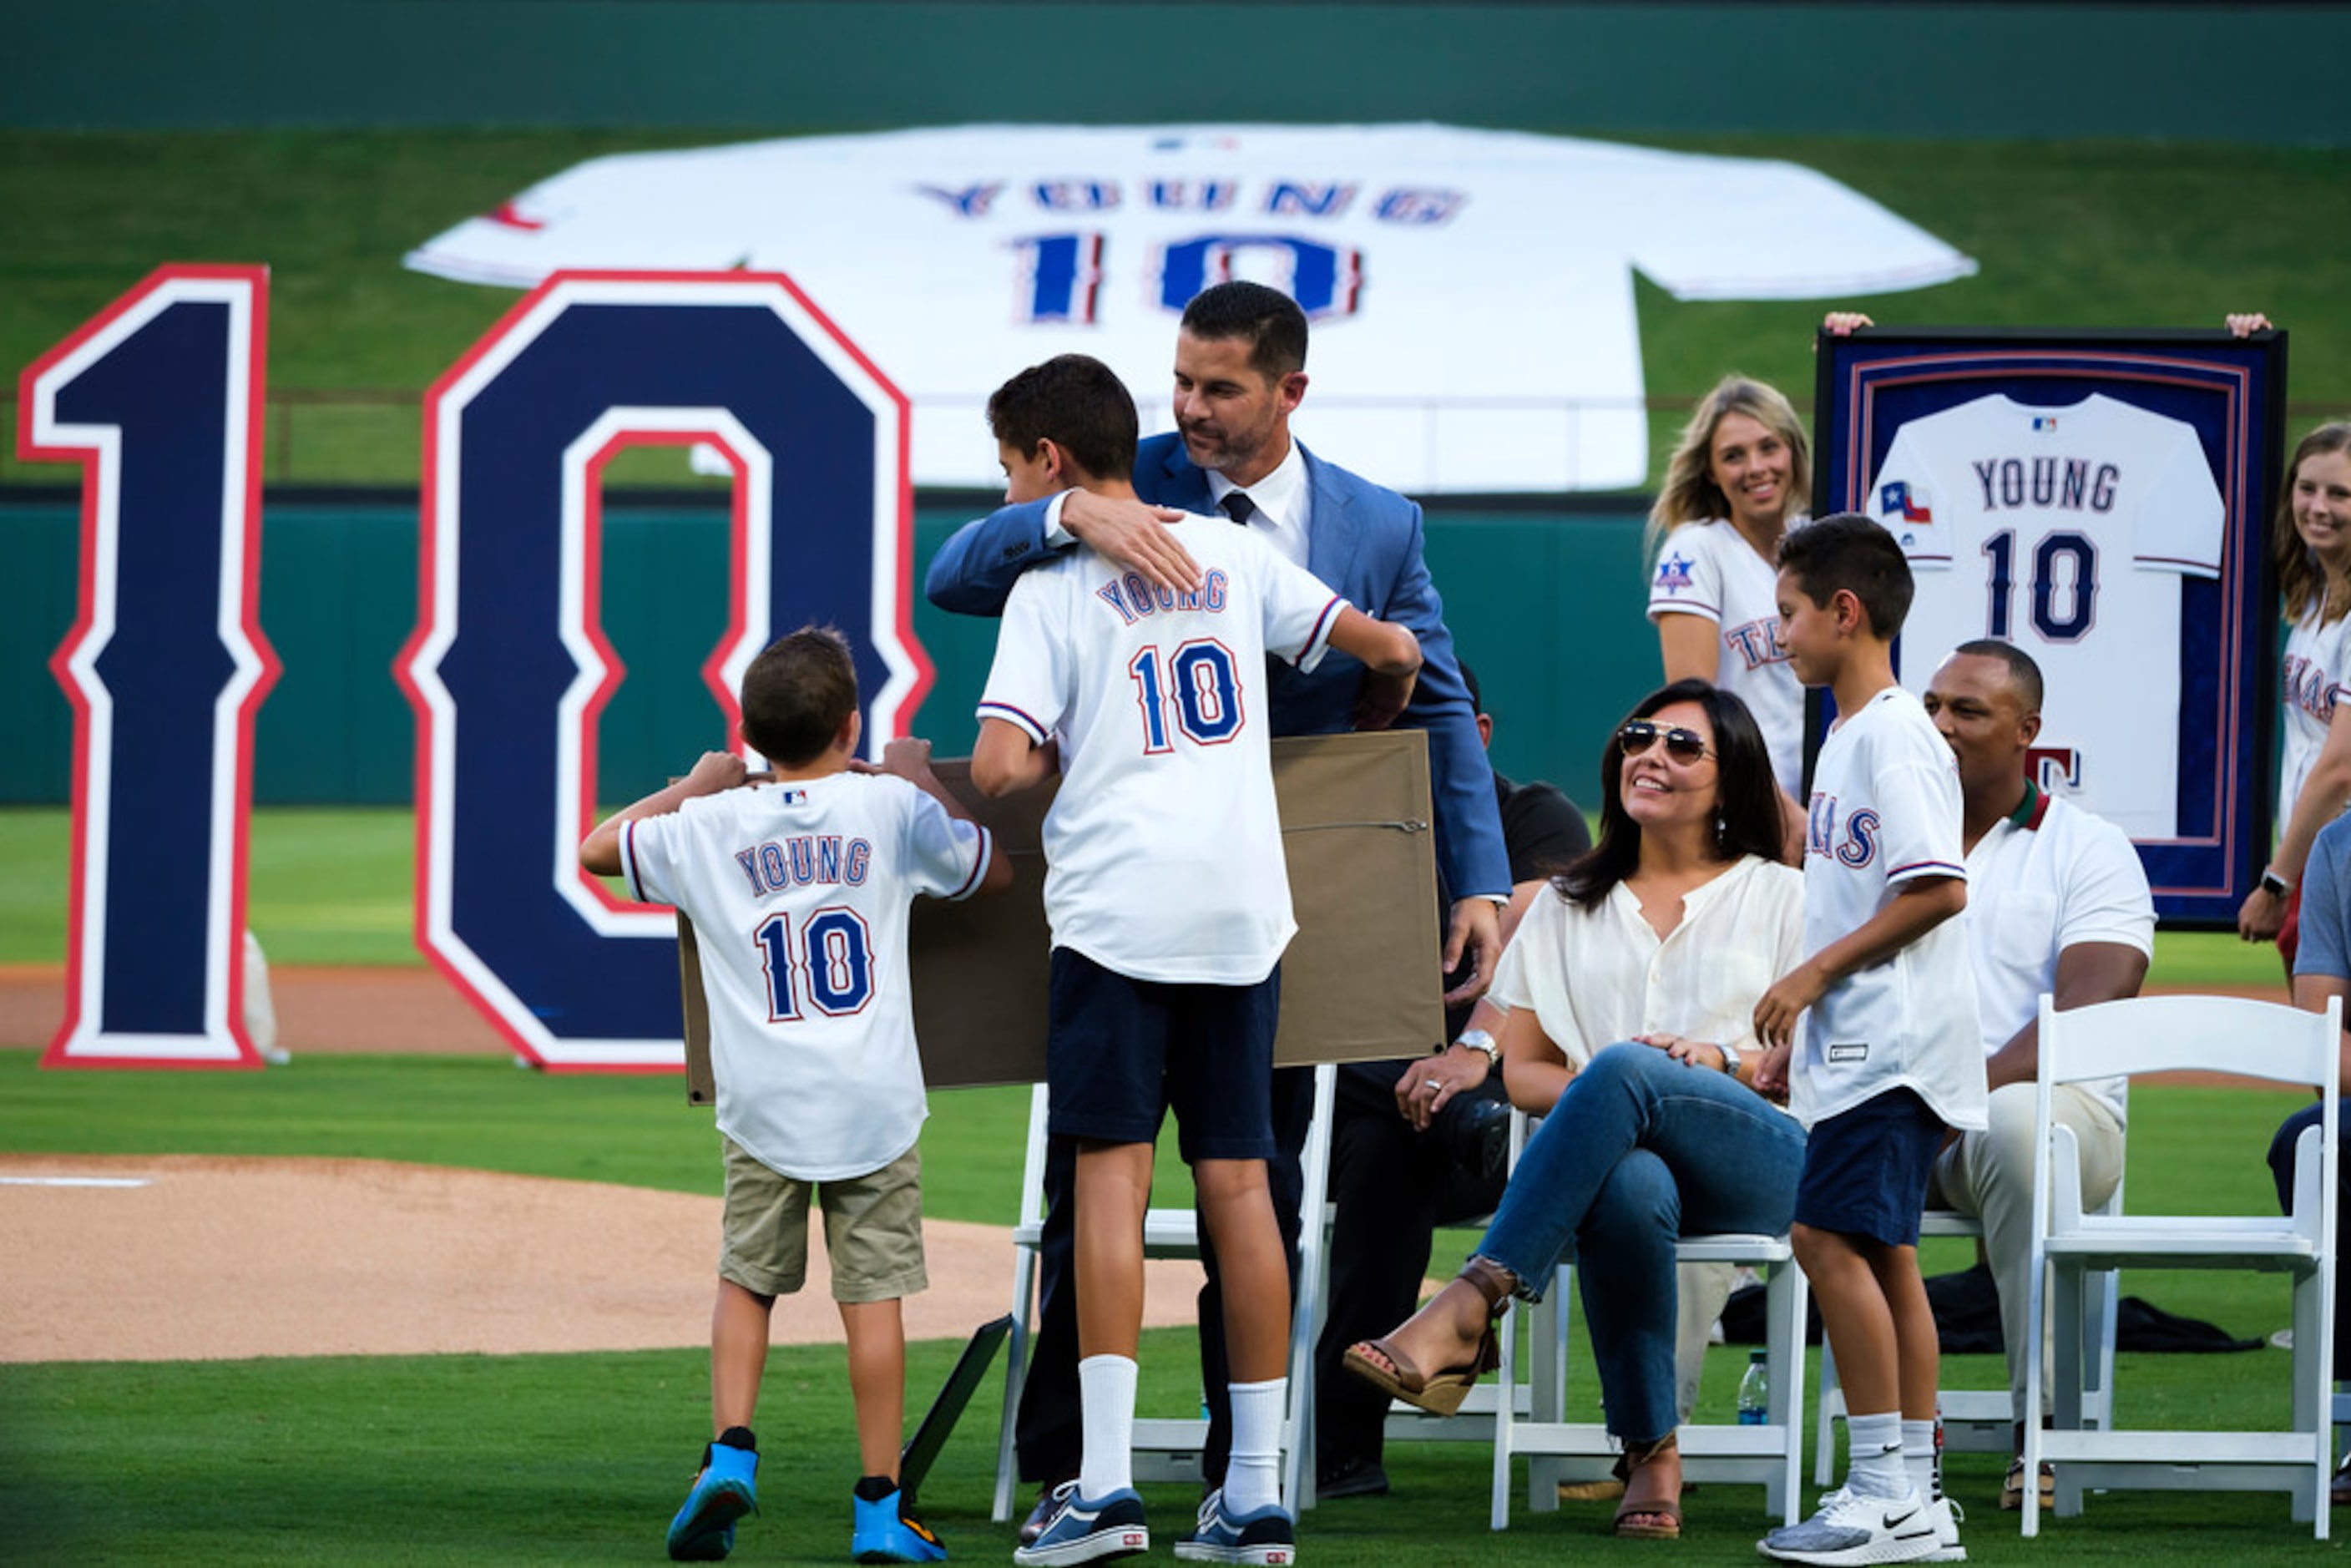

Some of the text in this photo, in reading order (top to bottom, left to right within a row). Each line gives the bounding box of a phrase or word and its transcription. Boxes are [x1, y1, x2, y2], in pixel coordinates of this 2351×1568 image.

[915, 178, 1468, 226] YOUNG
[1006, 232, 1364, 326] 10
[1972, 458, 2121, 514] YOUNG
[1980, 529, 2101, 645] 10
[17, 262, 937, 1072] 10
[1128, 636, 1246, 756] 10
[735, 835, 872, 898] YOUNG
[754, 905, 875, 1023] 10
